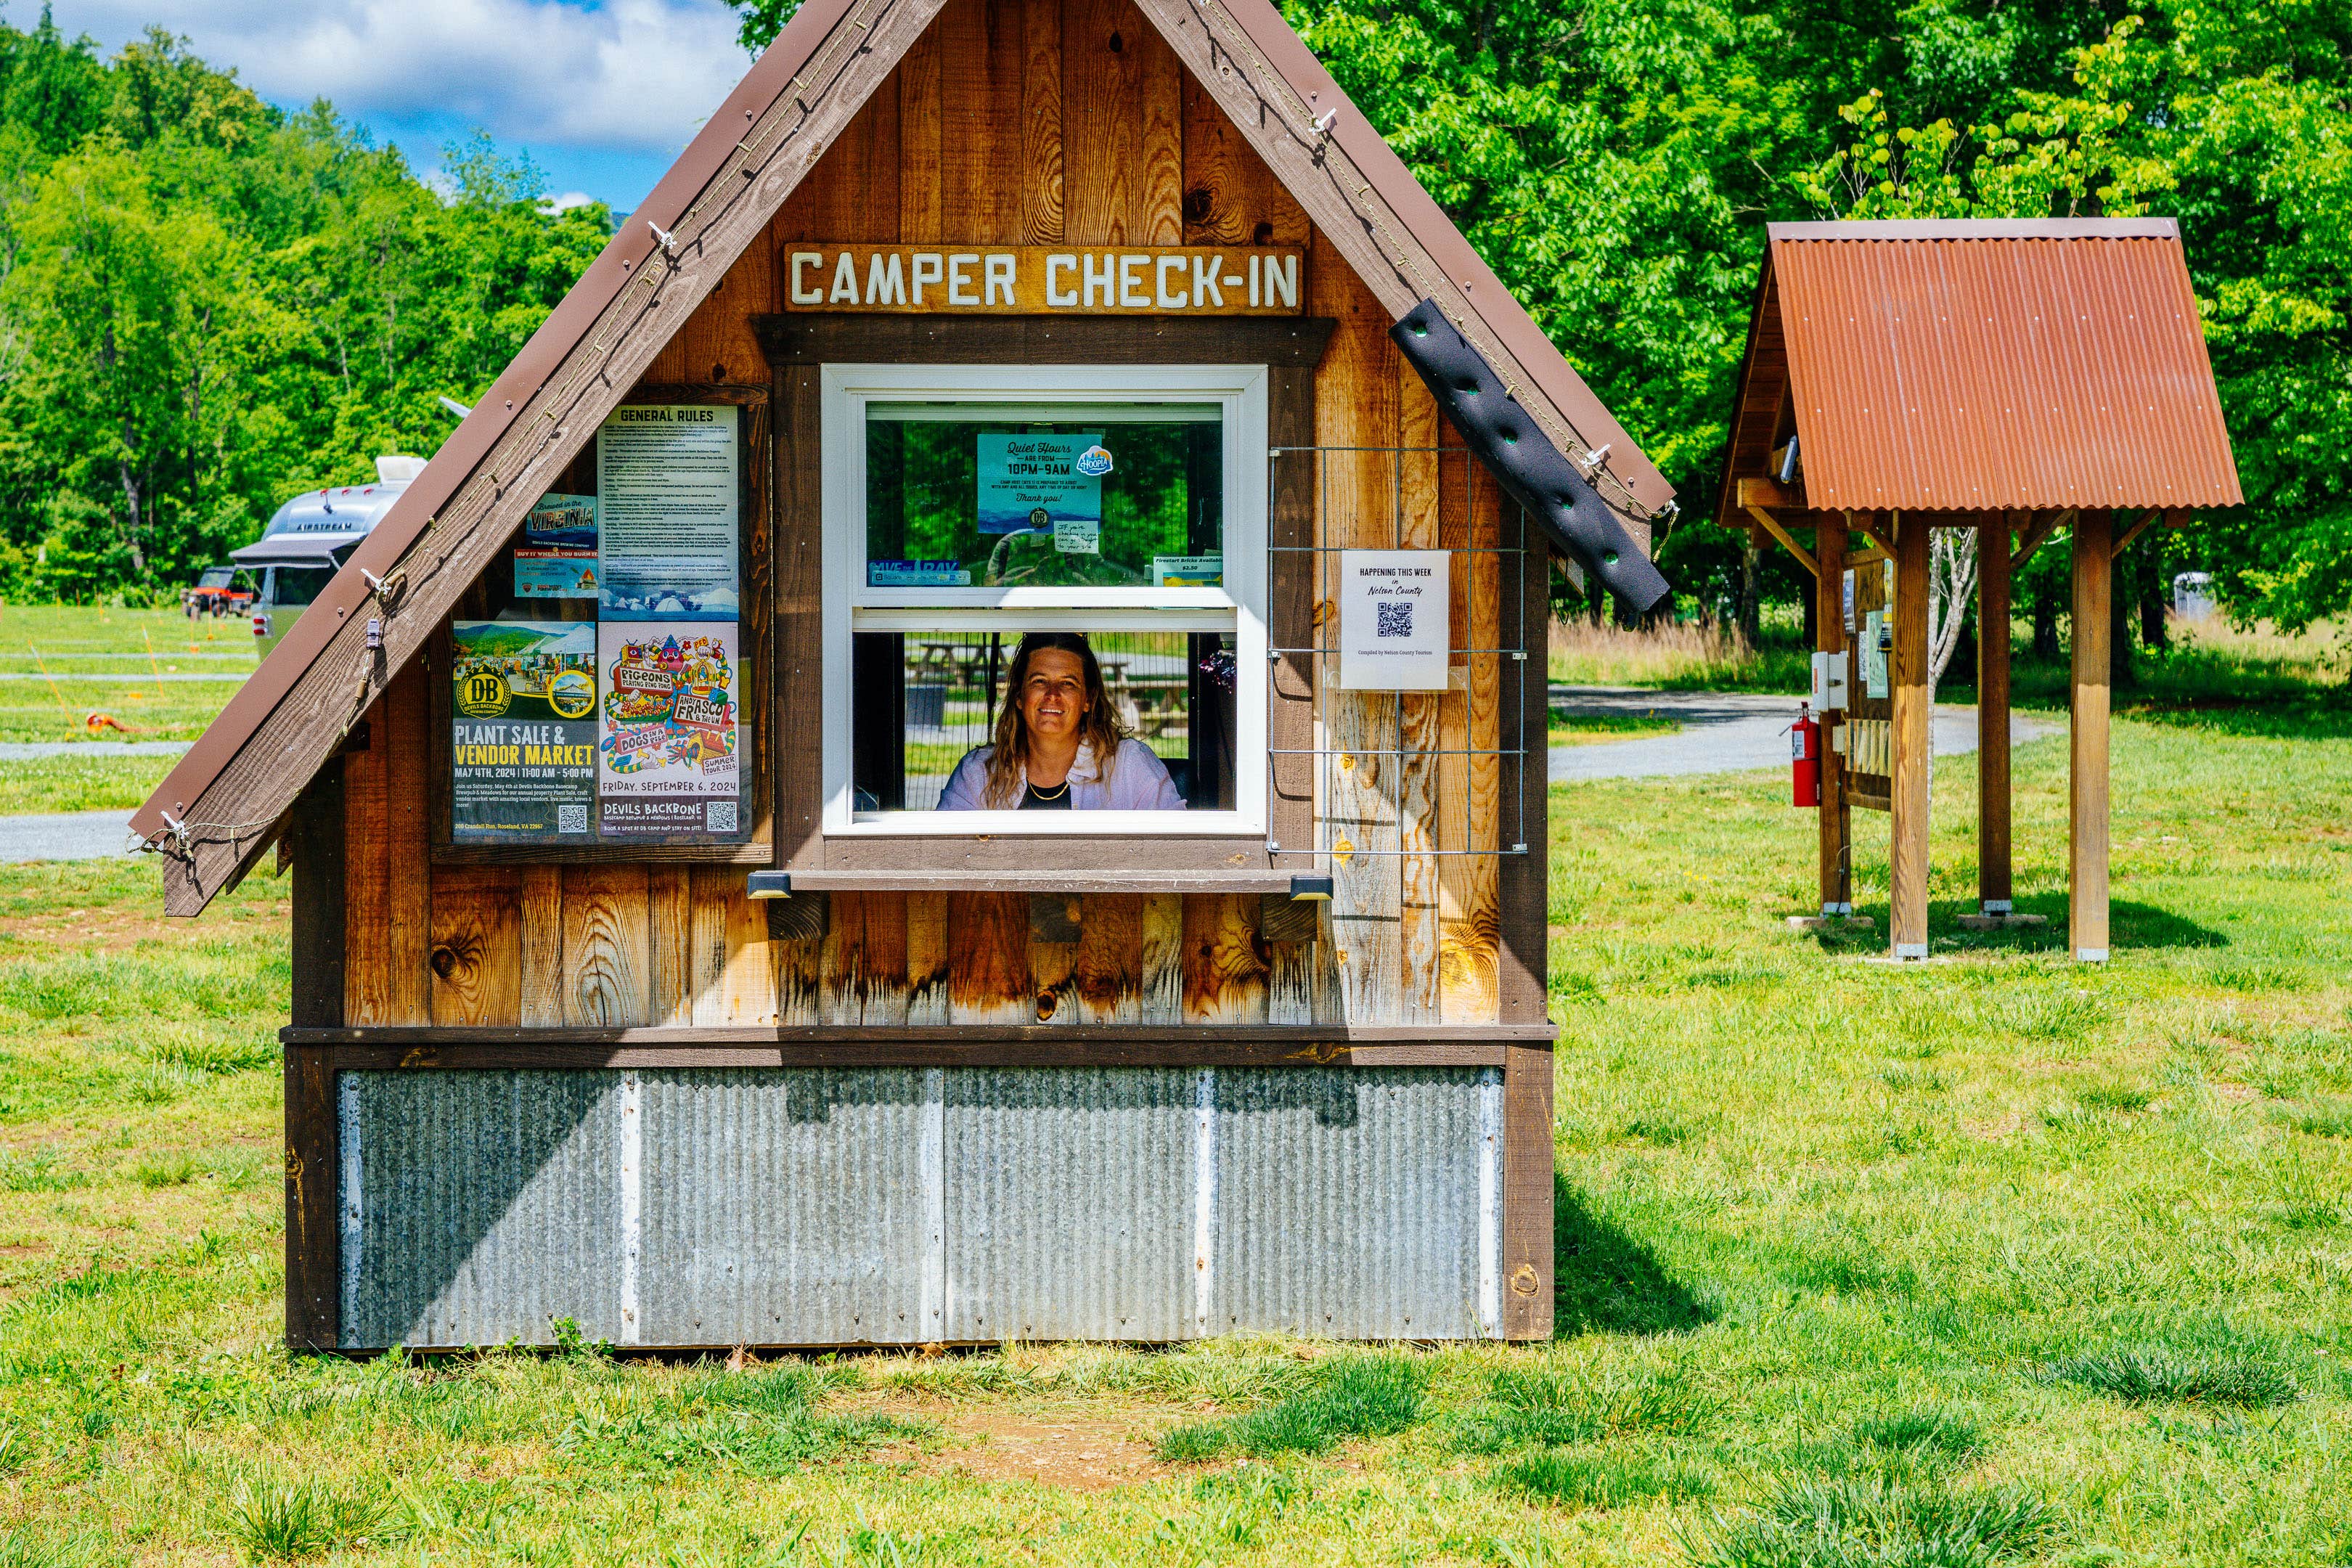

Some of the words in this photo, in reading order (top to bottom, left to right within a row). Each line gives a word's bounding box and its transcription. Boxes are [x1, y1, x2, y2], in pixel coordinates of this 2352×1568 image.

[792, 252, 1016, 304] CAMPER
[1047, 254, 1297, 308] CHECK-IN
[621, 410, 673, 422] GENERAL
[677, 410, 713, 422] RULES
[1008, 442, 1035, 456] Quiet
[1037, 442, 1072, 454] Hours
[1008, 464, 1070, 475] 10PM-9AM
[1080, 459, 1108, 470] HOOPLA
[1043, 494, 1063, 504] you!
[530, 507, 595, 531] VIRGINIA
[1034, 513, 1045, 522] DB
[1368, 586, 1393, 596] Nelson
[1395, 586, 1423, 597] County
[621, 669, 671, 684] PiGeONS
[470, 679, 499, 702] DB
[679, 696, 696, 706] ANDY
[455, 726, 506, 745] PLANT
[512, 726, 550, 745] SALE
[554, 726, 565, 745] &
[621, 733, 649, 751] DOGS
[455, 745, 520, 765] VENDOR
[525, 745, 594, 765] MARKET
[455, 768, 473, 777] MAY
[475, 768, 494, 778] 4TH,
[496, 768, 515, 777] 2024
[522, 768, 540, 777] 11:00
[542, 768, 555, 777] AM
[563, 768, 579, 777] 5:00
[581, 768, 593, 777] PM
[705, 766, 721, 775] TOUR
[642, 782, 694, 791] SEPTEMBER
[710, 782, 736, 791] 2024
[604, 803, 640, 814] DEVILS
[645, 803, 702, 814] BACKBONE
